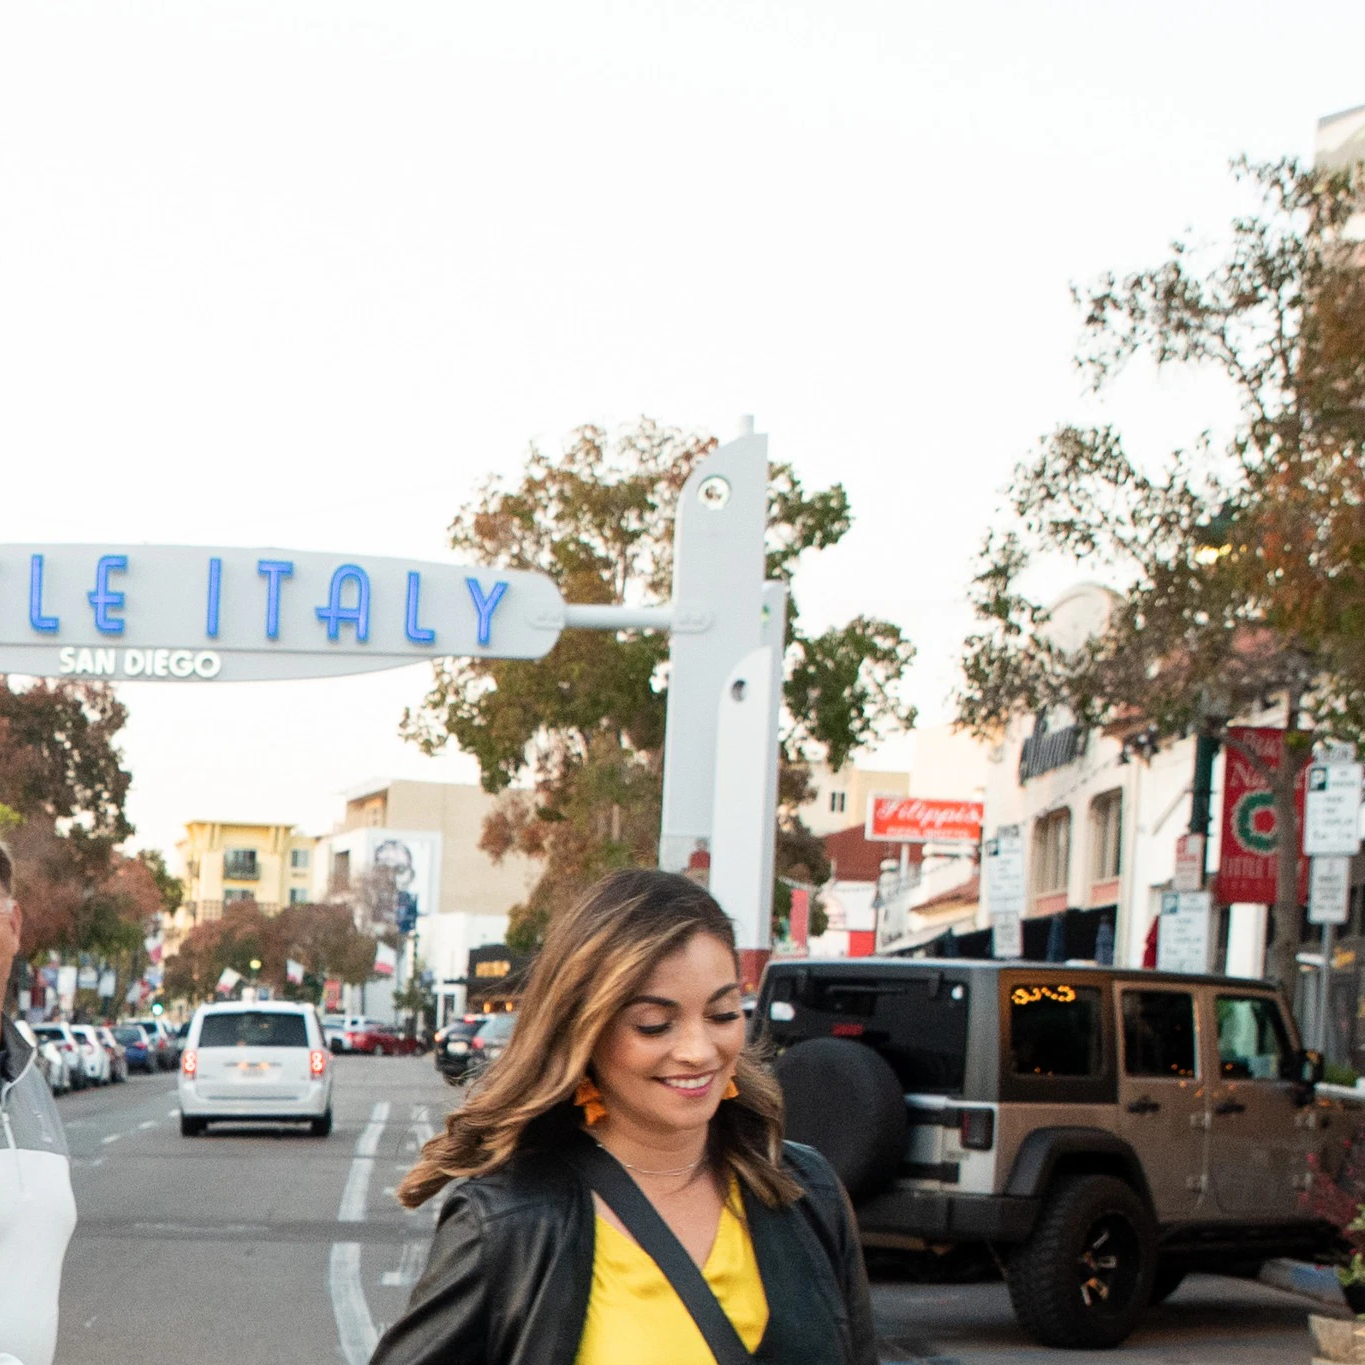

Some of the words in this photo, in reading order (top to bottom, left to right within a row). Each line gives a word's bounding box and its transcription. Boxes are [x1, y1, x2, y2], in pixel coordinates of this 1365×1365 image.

[206, 557, 510, 647] ITALY
[58, 646, 117, 676] SAN
[123, 648, 222, 679] DIEGO
